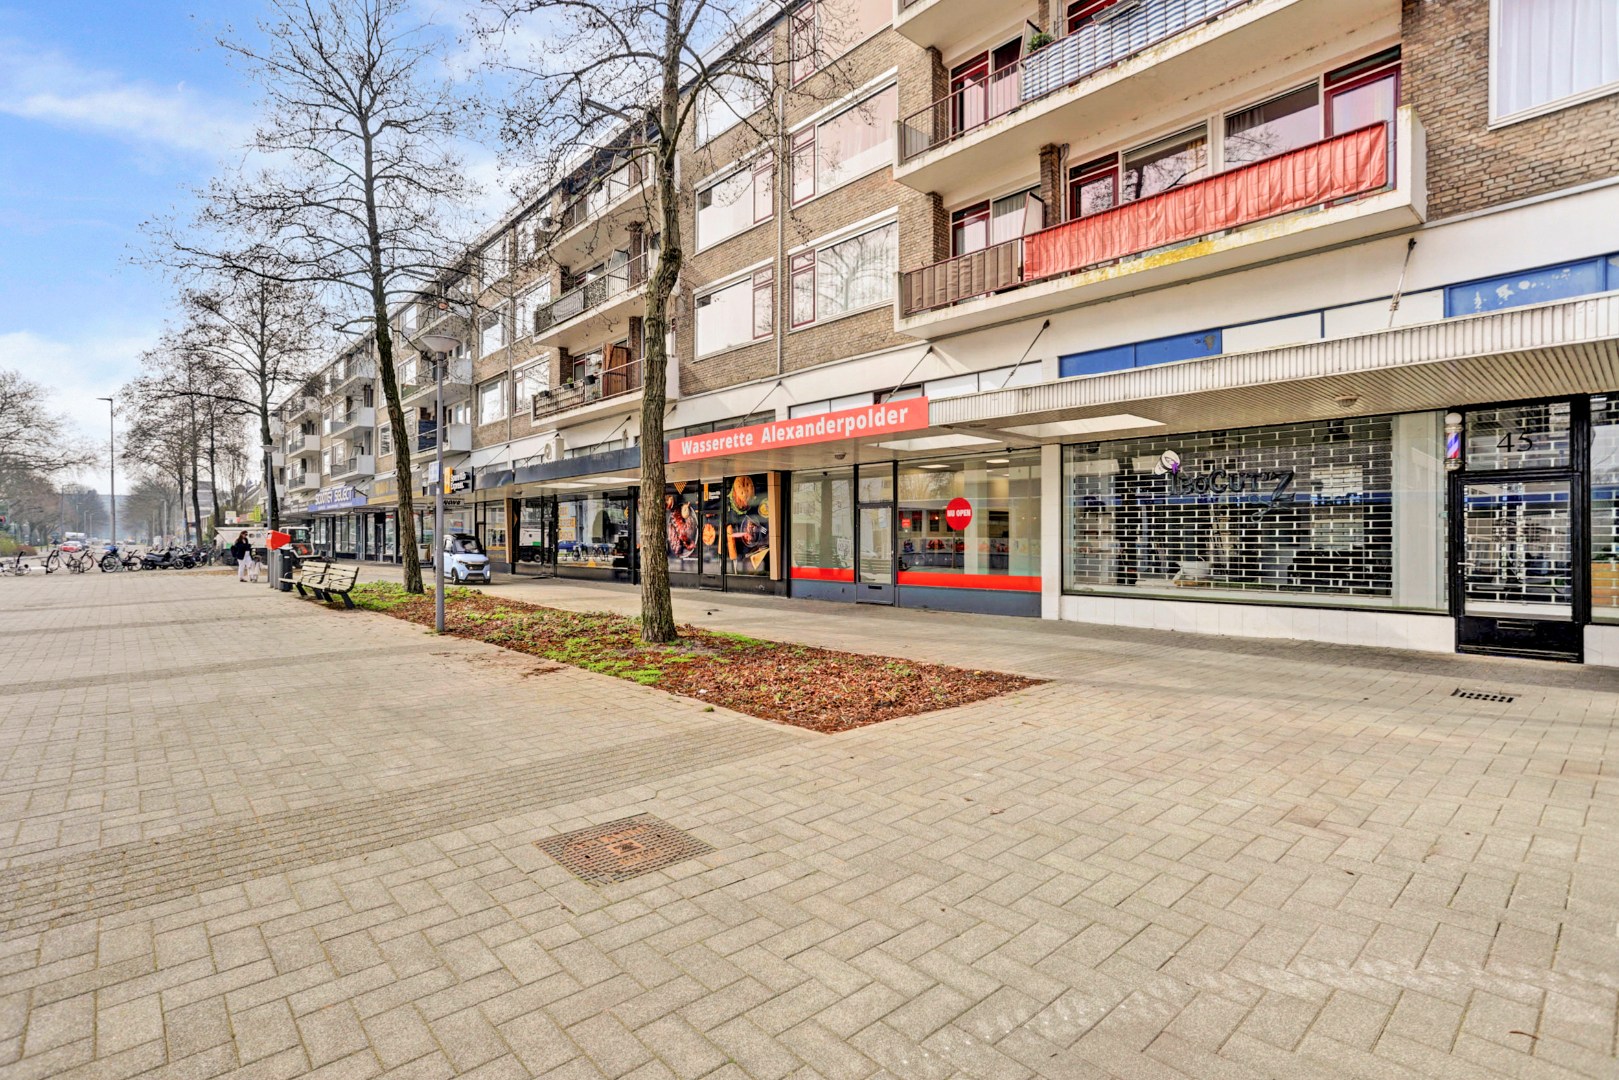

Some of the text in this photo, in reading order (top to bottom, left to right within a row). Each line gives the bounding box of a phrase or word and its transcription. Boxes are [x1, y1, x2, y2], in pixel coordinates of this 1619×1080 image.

[681, 406, 909, 456] Wasserette Alexanderpolder
[1496, 428, 1533, 452] 45
[956, 509, 971, 517] OPEN
